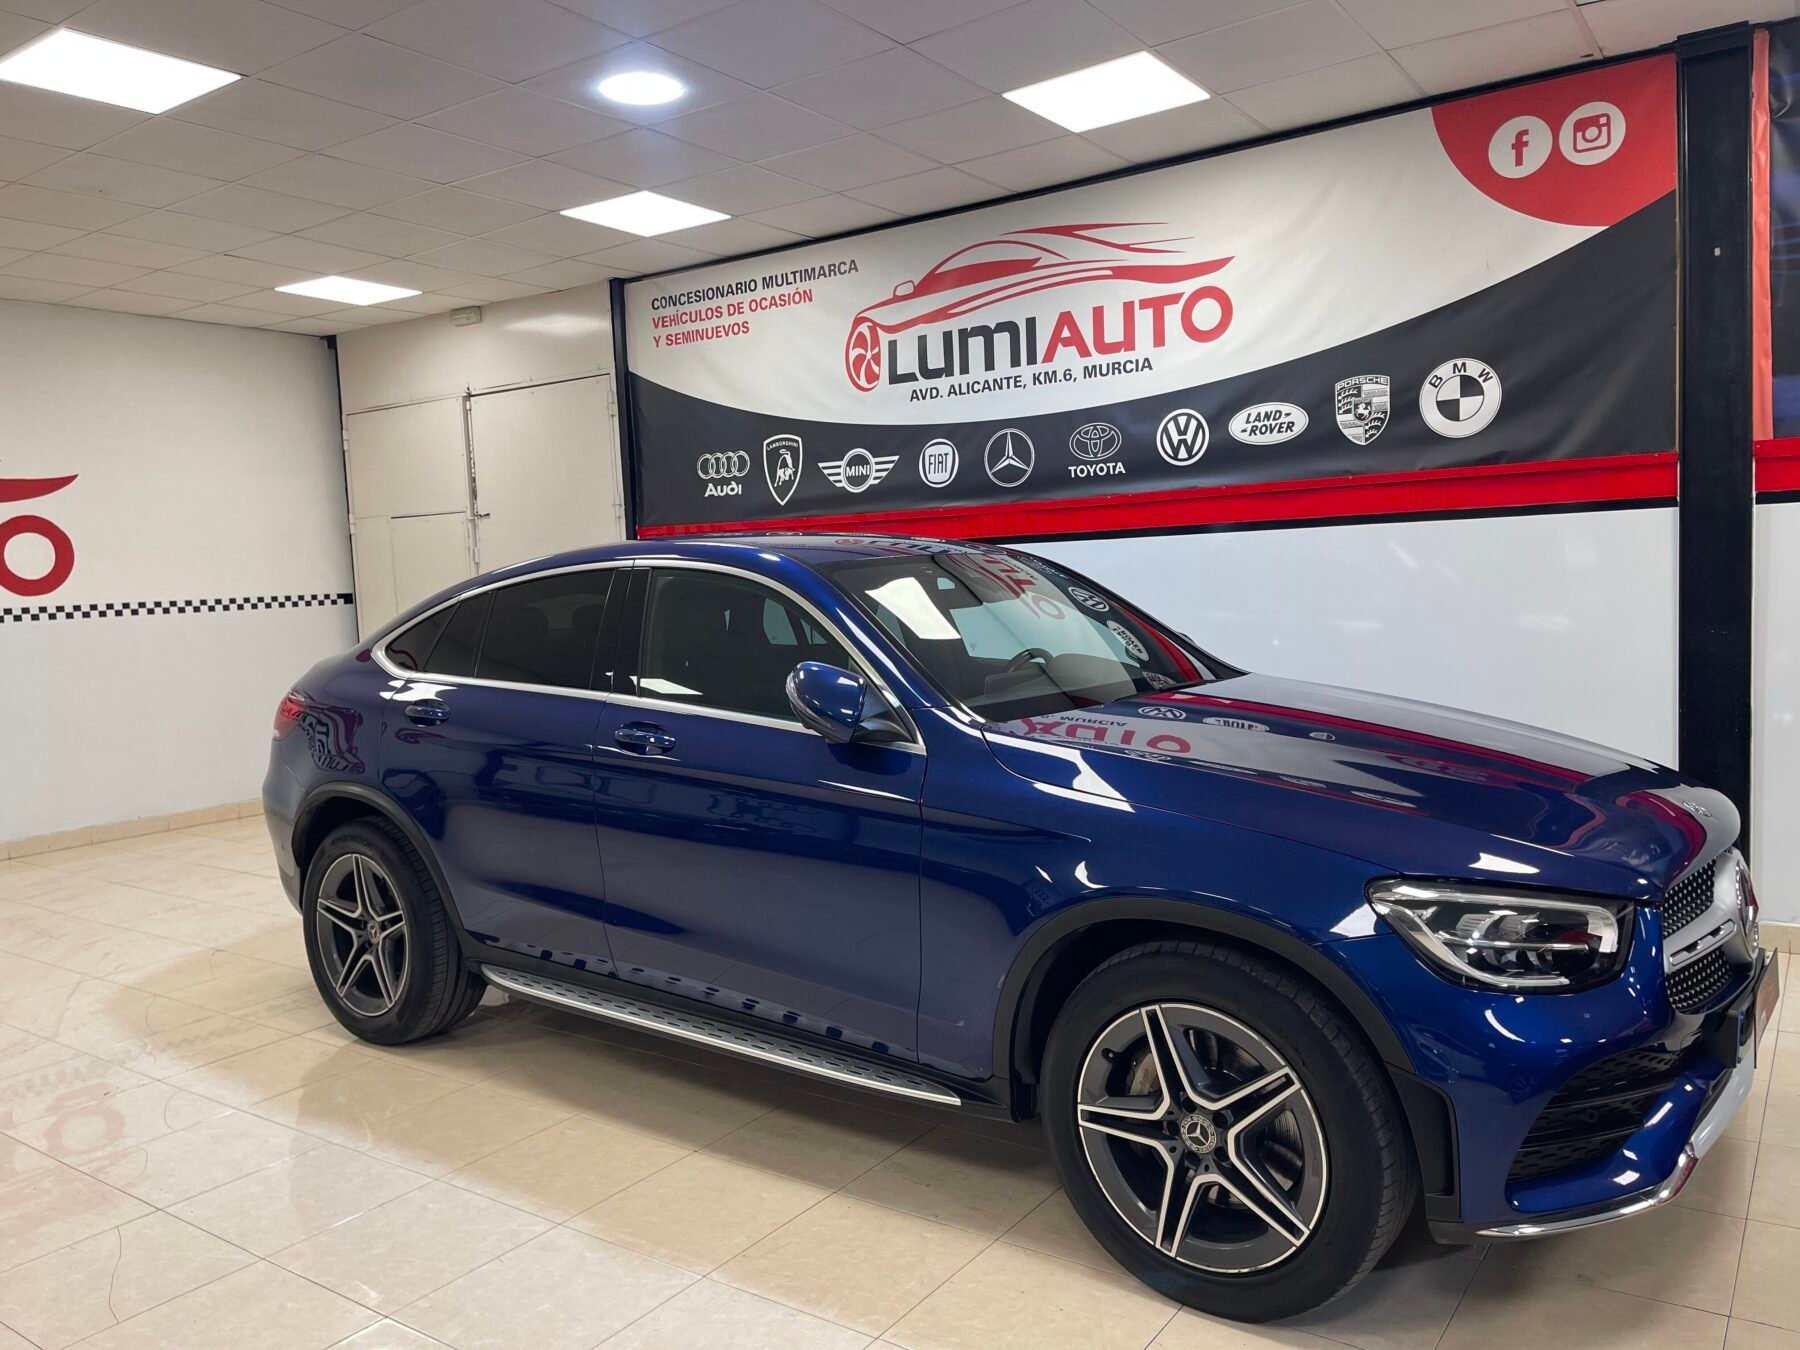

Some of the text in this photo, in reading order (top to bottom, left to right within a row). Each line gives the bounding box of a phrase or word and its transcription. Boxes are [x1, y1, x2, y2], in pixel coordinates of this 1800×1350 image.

[651, 259, 859, 311] CONCESIONARIO MULTIMARCA
[652, 287, 813, 330] VEHÍCULOS DE OCASIÓN
[653, 320, 750, 348] Y SEMINUEVOS
[909, 357, 1153, 402] AVD. ALICANTE, KM.6, MURCIA
[1337, 376, 1389, 391] PORSCHE
[1428, 361, 1494, 390] BMW
[766, 439, 799, 451] LAMBORGHINI
[845, 464, 870, 477] MINI
[928, 452, 950, 475] FIAT
[1068, 461, 1126, 479] TOYOTA
[704, 481, 742, 498] Audi
